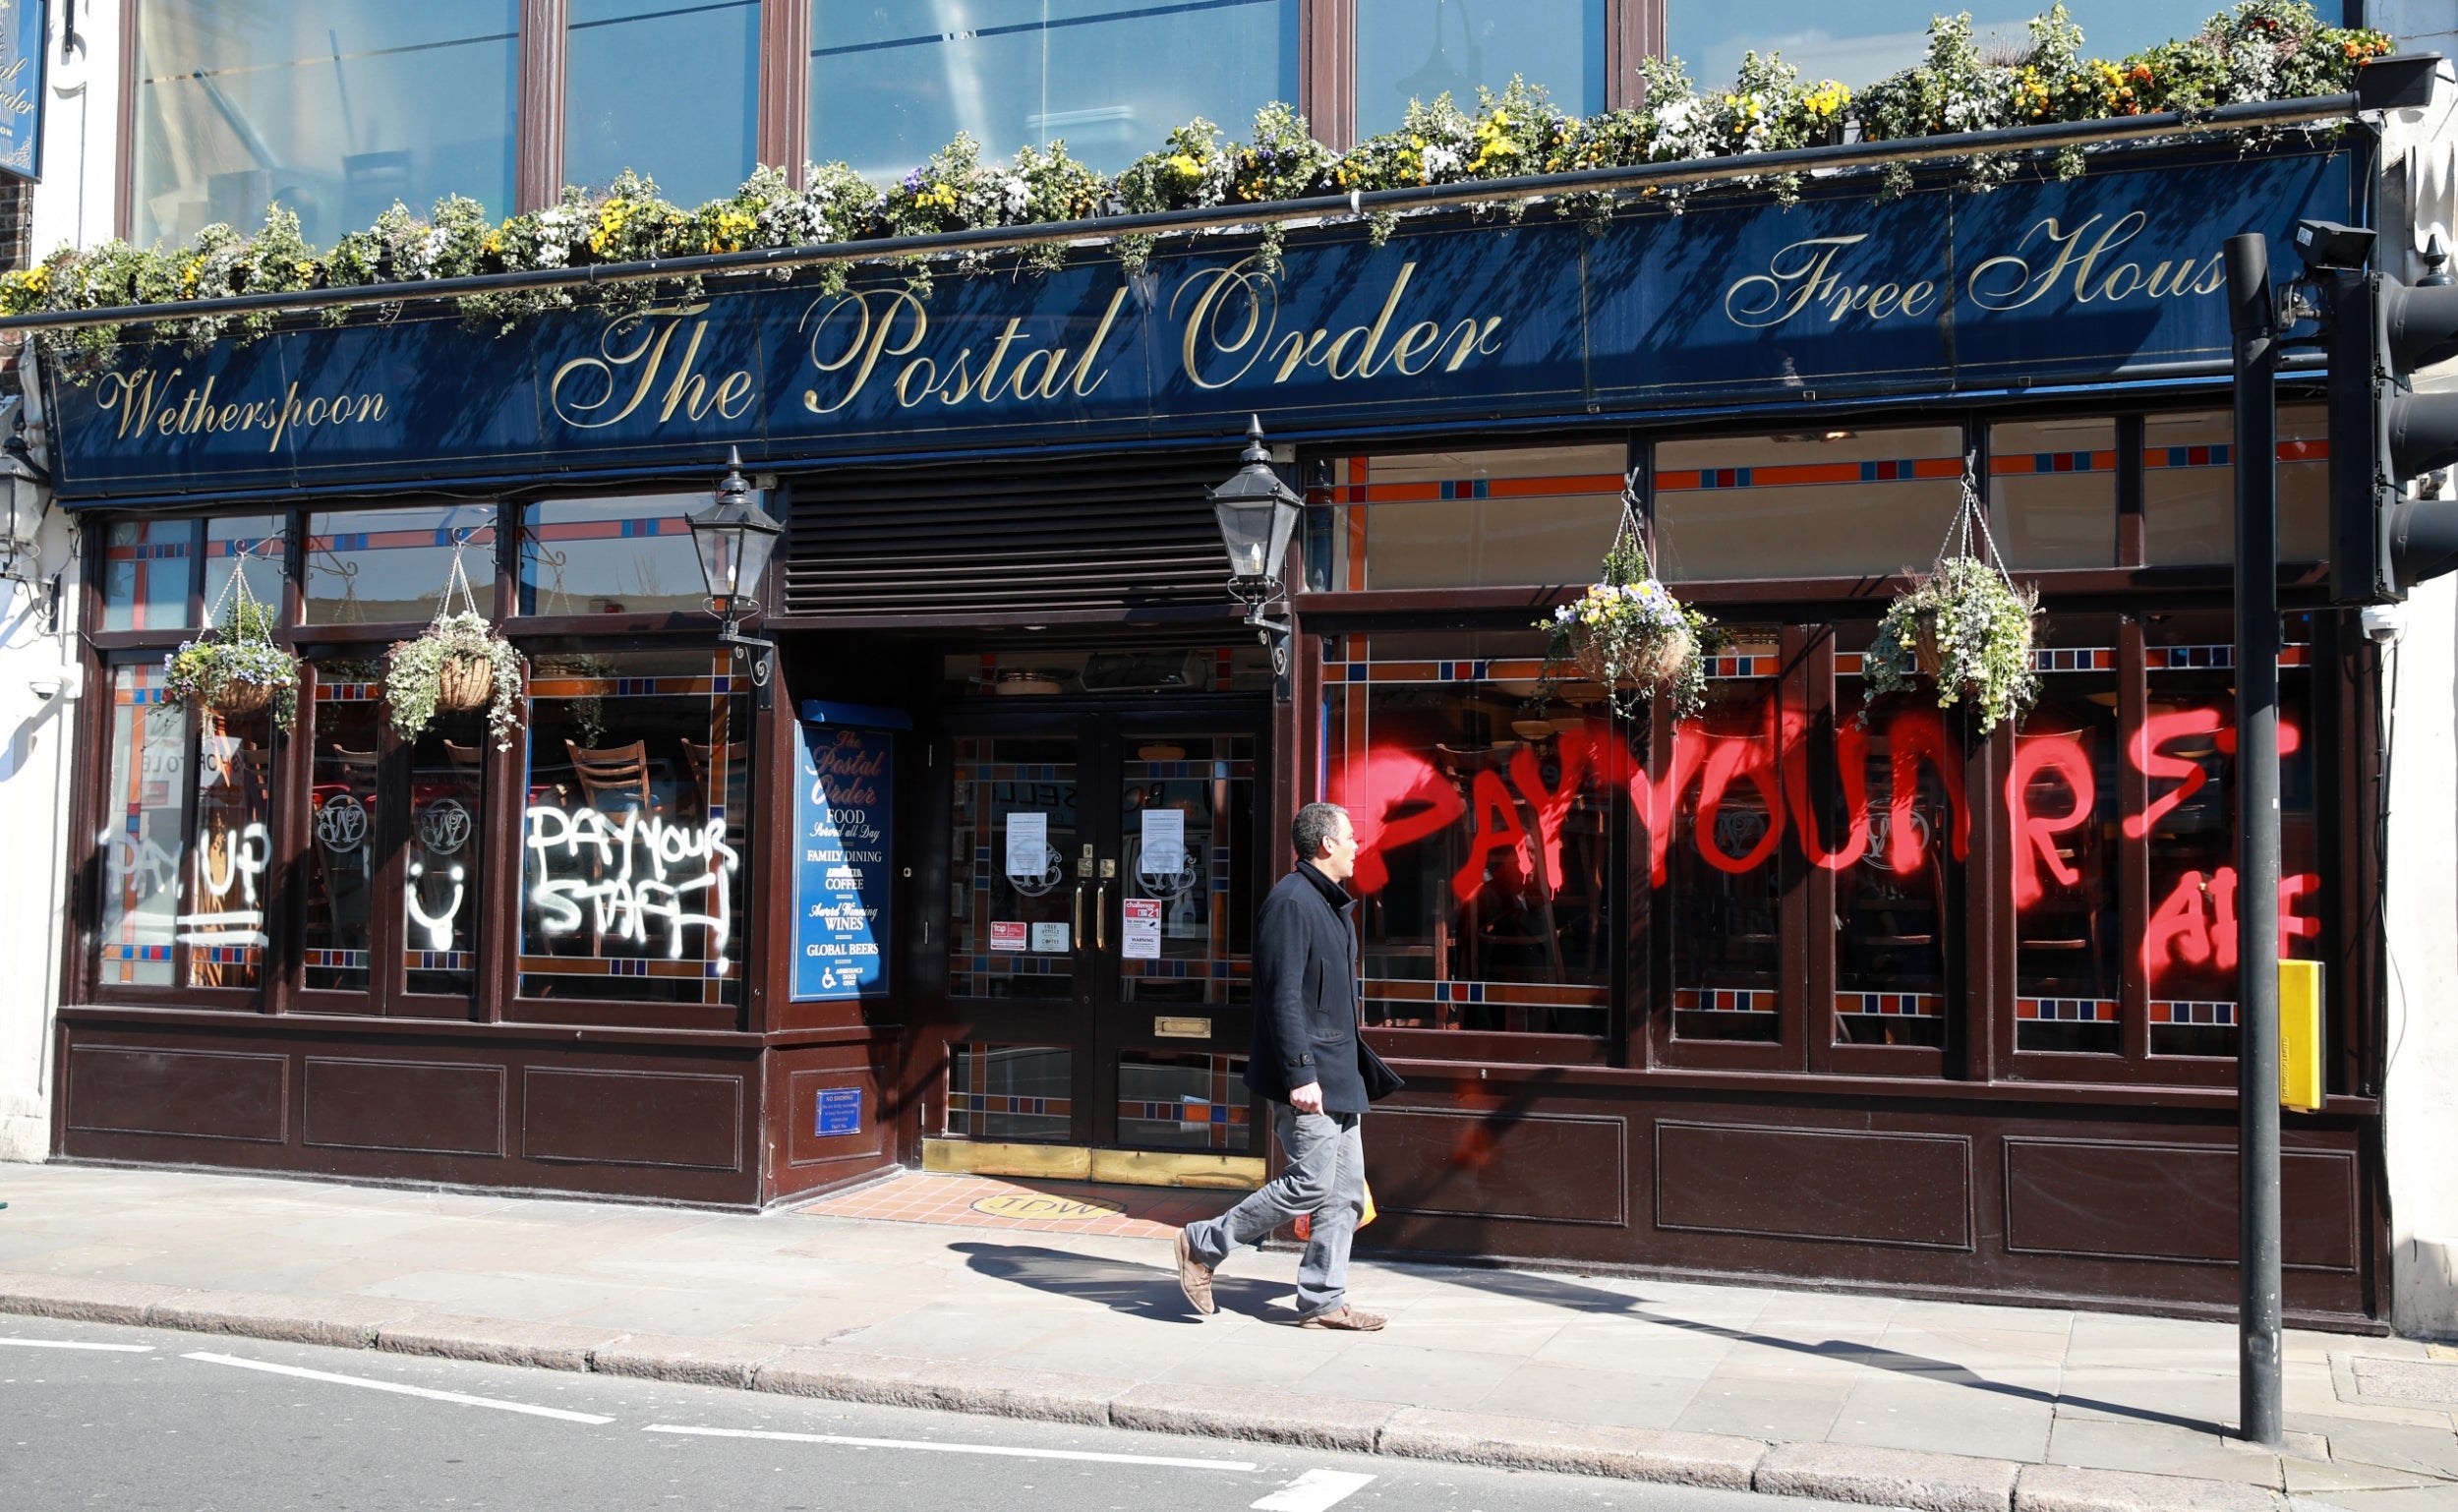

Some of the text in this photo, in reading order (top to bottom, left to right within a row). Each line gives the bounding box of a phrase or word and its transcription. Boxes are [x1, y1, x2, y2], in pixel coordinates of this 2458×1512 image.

[1725, 210, 2225, 327] Free Hous
[552, 258, 1501, 428] The Postal Order
[96, 368, 389, 452] Wetherspoon
[805, 745, 886, 777] Postal
[811, 774, 877, 805] Order
[826, 808, 865, 824] FOOD
[1329, 727, 1595, 901] PAY
[526, 803, 638, 883] PAY
[637, 815, 738, 881] YOUR
[809, 822, 880, 843] Served all Day
[201, 822, 272, 903] UP
[807, 849, 882, 862] FAMILY DINING
[825, 878, 864, 891] COFFEE
[809, 901, 878, 921] Award Winning
[824, 916, 864, 931] WINES
[806, 943, 879, 957] GLOBAL BEERS
